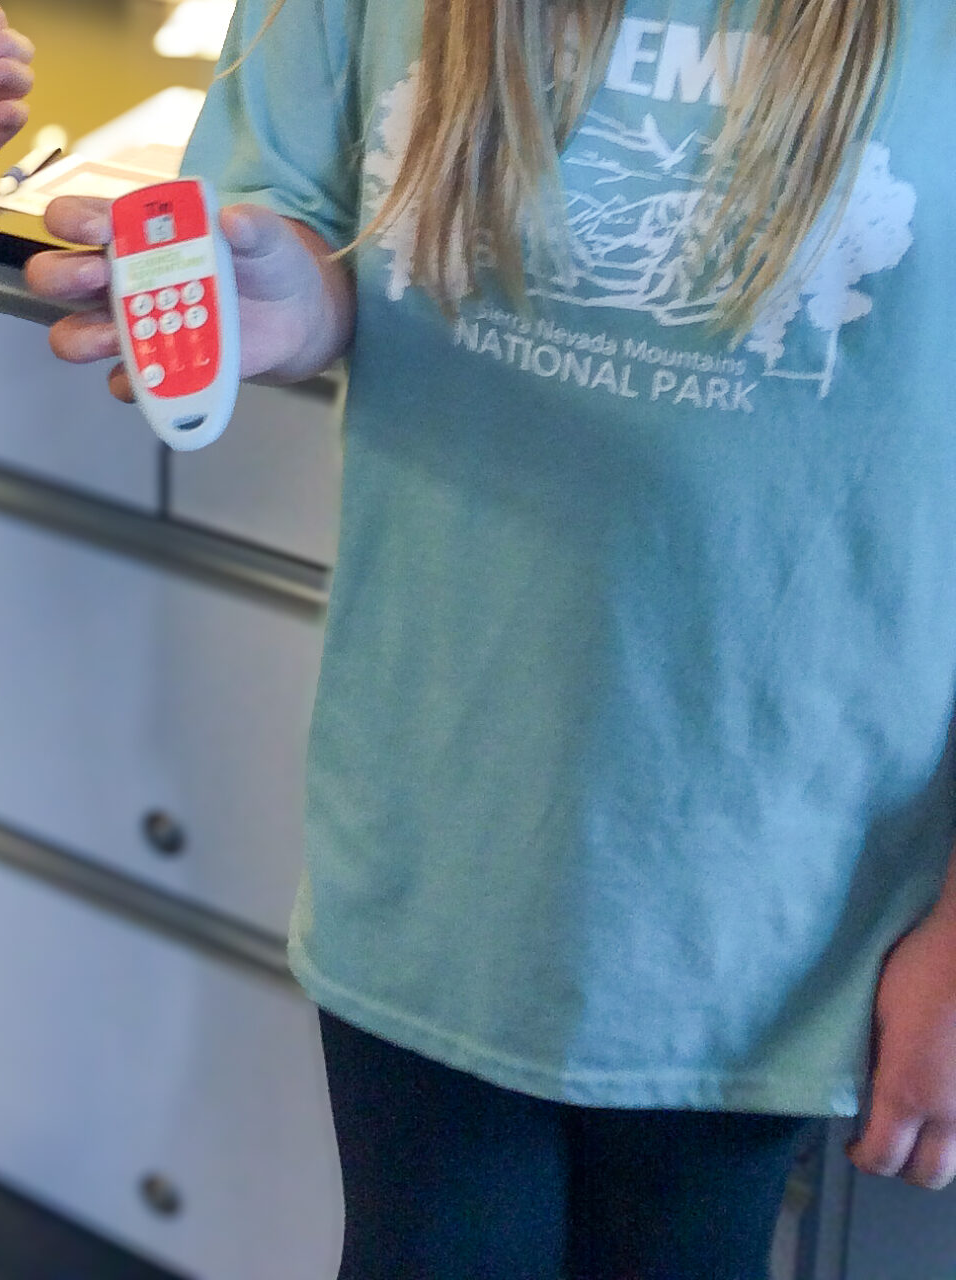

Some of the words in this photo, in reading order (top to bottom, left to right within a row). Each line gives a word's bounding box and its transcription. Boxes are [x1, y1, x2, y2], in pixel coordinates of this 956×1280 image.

[455, 317, 639, 399] NATIONAL
[650, 368, 760, 413] PARK
[538, 317, 618, 355] Nevada
[622, 337, 746, 375] Mountains
